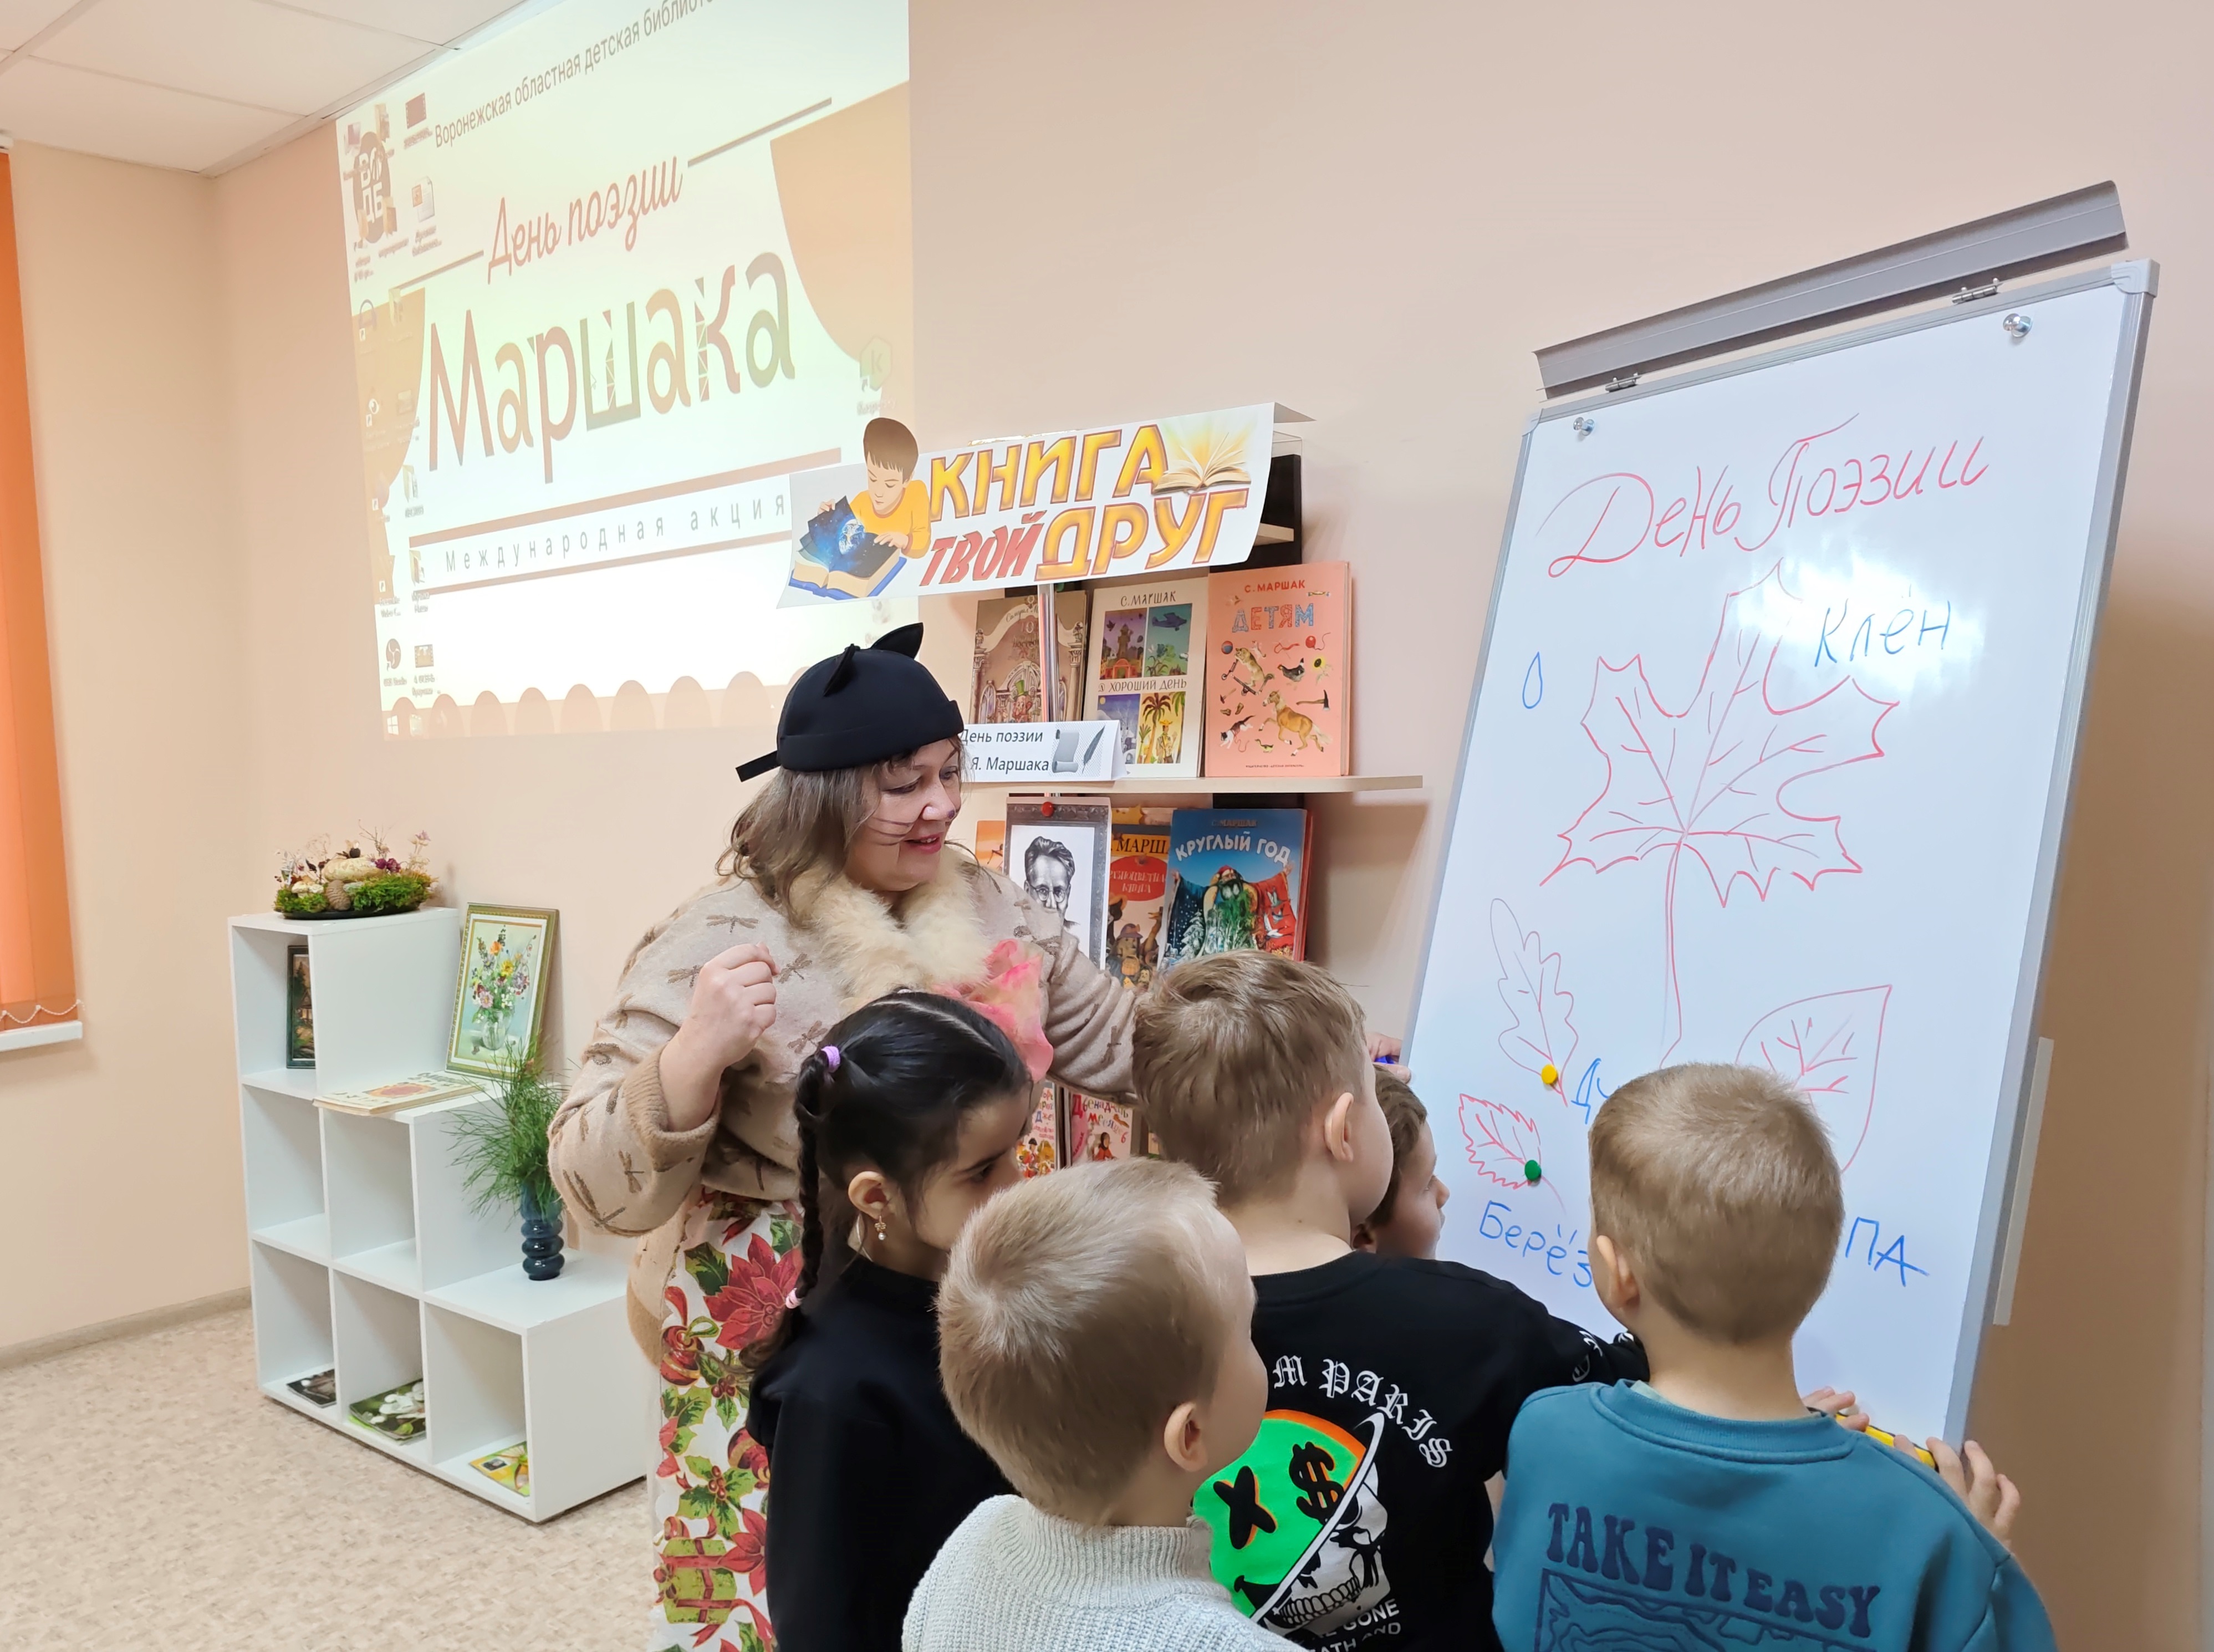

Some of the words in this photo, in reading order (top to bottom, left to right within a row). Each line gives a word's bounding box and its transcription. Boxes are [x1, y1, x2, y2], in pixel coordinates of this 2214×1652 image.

[435, 91, 512, 148] Воронежская
[515, 54, 581, 105] областная
[585, 21, 640, 75] детская
[644, 0, 712, 37] библио
[487, 197, 562, 284] День
[568, 156, 683, 252] поэзии
[428, 252, 796, 484] Маршака
[930, 424, 1169, 522] КНИГА
[446, 516, 664, 572] Международная
[690, 494, 785, 531] акция
[920, 510, 1047, 587] ТВОЙ
[1034, 488, 1249, 580] ДРУГ
[1232, 603, 1314, 633] ДЕТЯМ
[1257, 580, 1305, 592] МАРШАК
[1109, 680, 1156, 692] ХОРОШИЙ
[961, 729, 992, 745] День
[996, 732, 1043, 742] поэзии
[986, 757, 1049, 774] Маршака
[1116, 838, 1168, 854] МАРШ
[1175, 830, 1251, 861] КРУГЛЫЙ
[1257, 838, 1290, 868] ГОД
[1479, 1201, 1592, 1288] Берёз
[1845, 1217, 1930, 1287] ПА
[1319, 1358, 1452, 1468] PARIS
[1546, 1502, 1674, 1591] TAKE
[1684, 1543, 1736, 1602] IT
[1743, 1568, 1881, 1638] EASY
